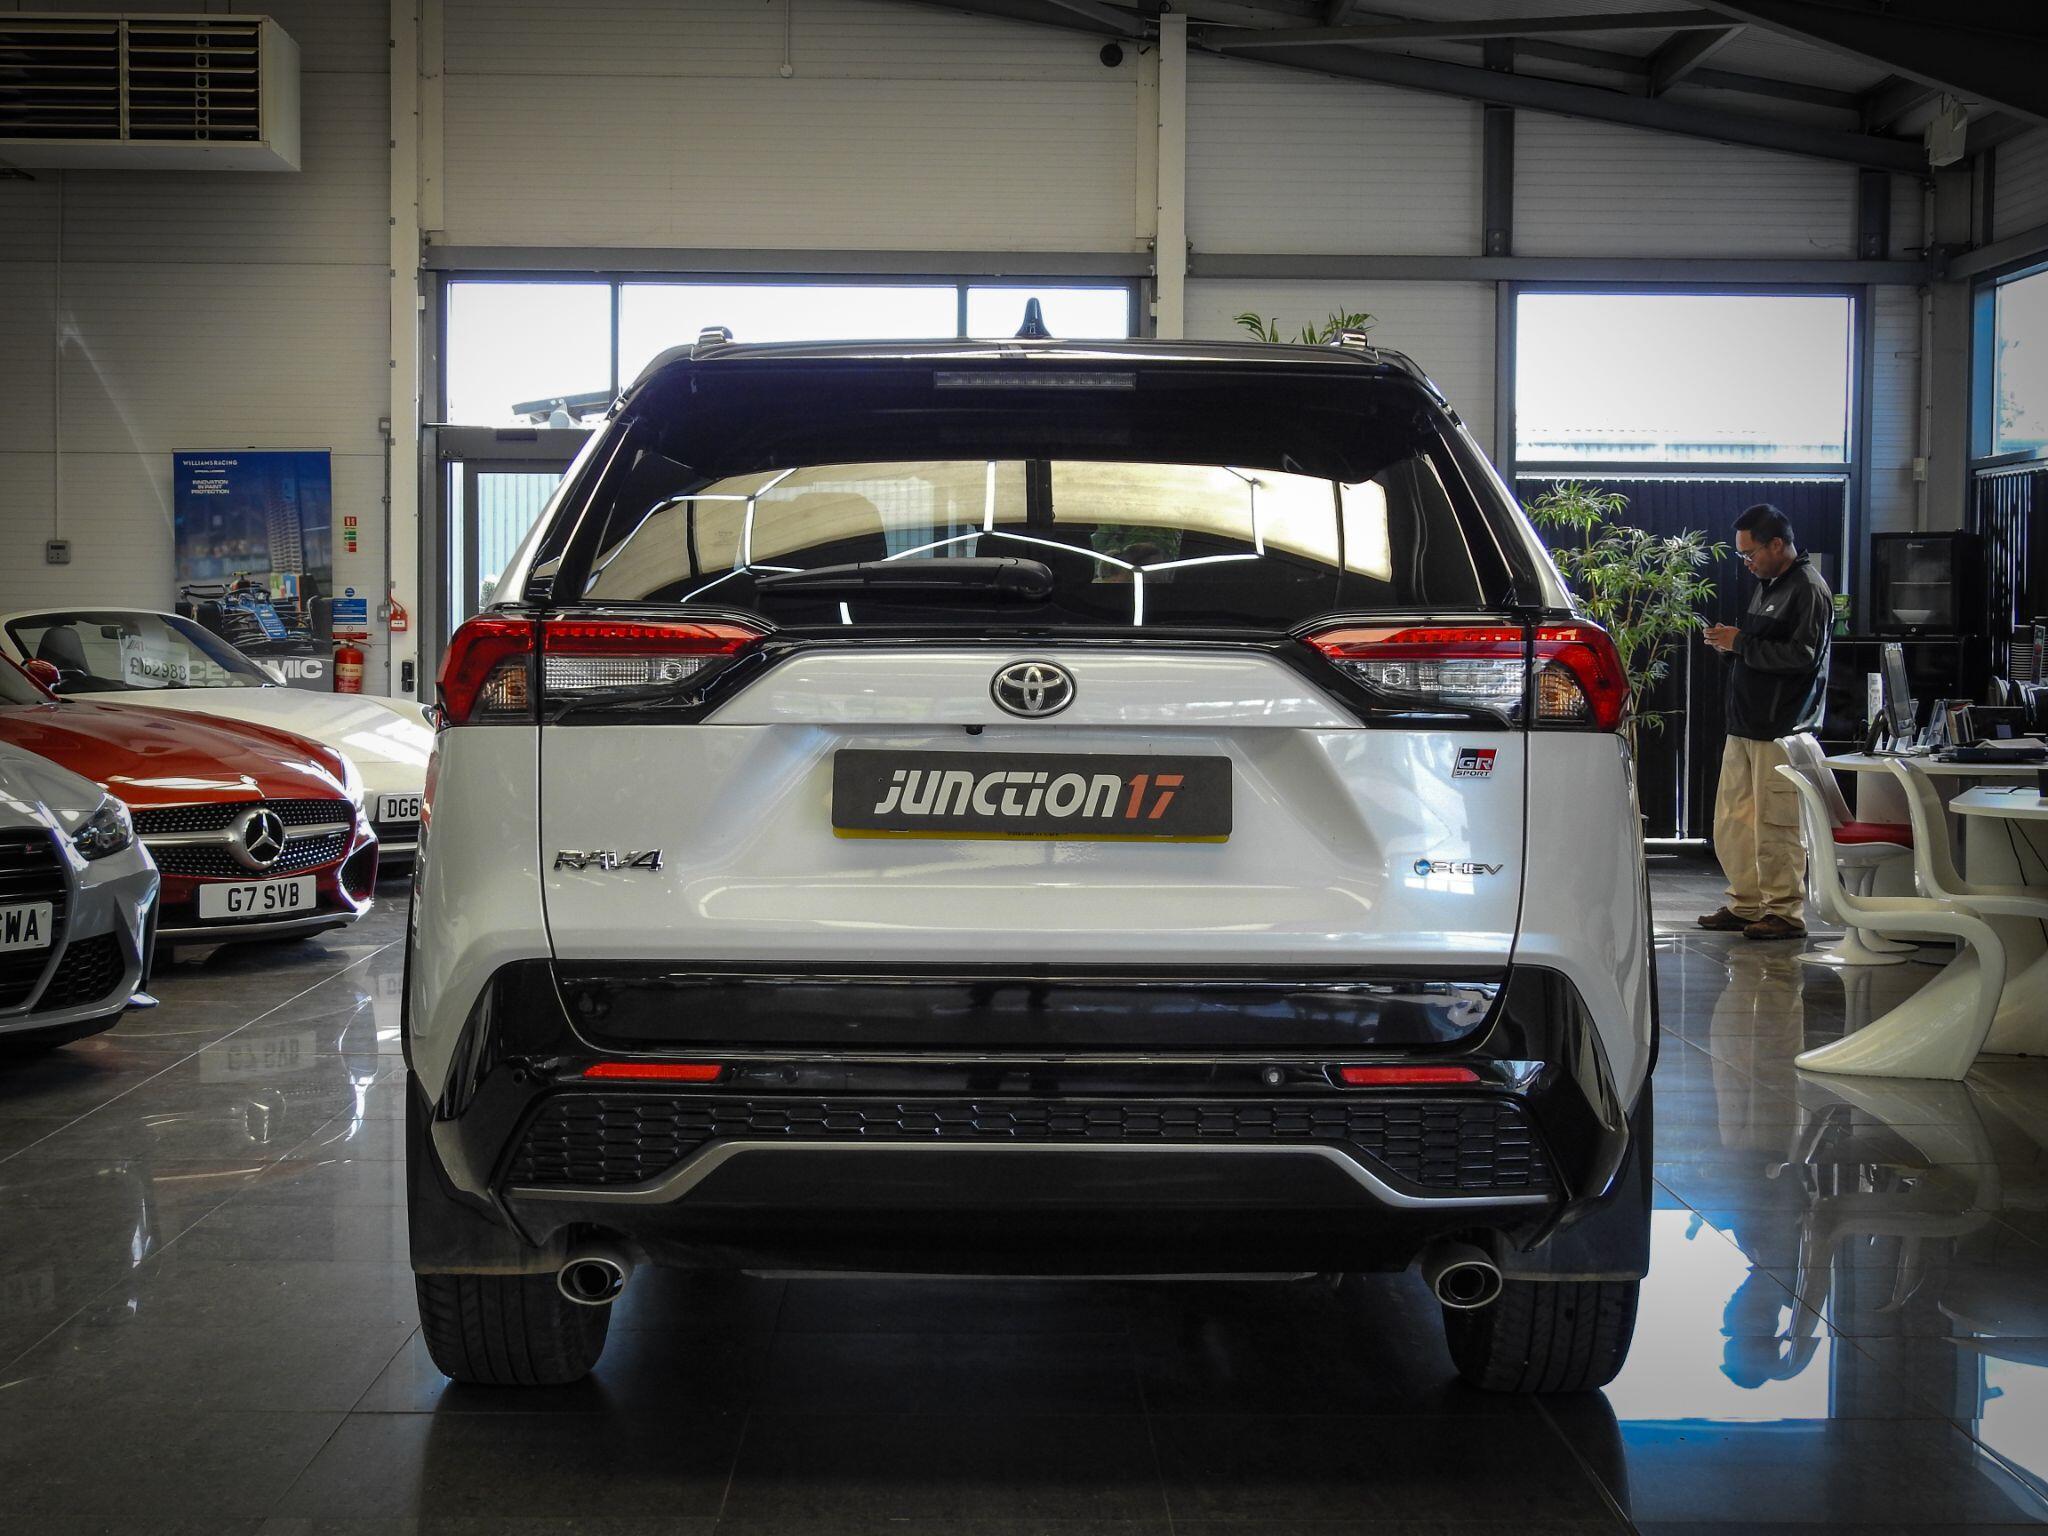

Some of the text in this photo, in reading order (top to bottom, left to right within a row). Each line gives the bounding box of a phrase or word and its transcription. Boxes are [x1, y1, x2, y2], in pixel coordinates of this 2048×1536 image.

[1458, 757, 1492, 770] GR
[387, 798, 422, 818] DG6
[554, 849, 664, 871] RAV4
[228, 883, 299, 912] G7 SVB
[0, 909, 39, 944] WA
